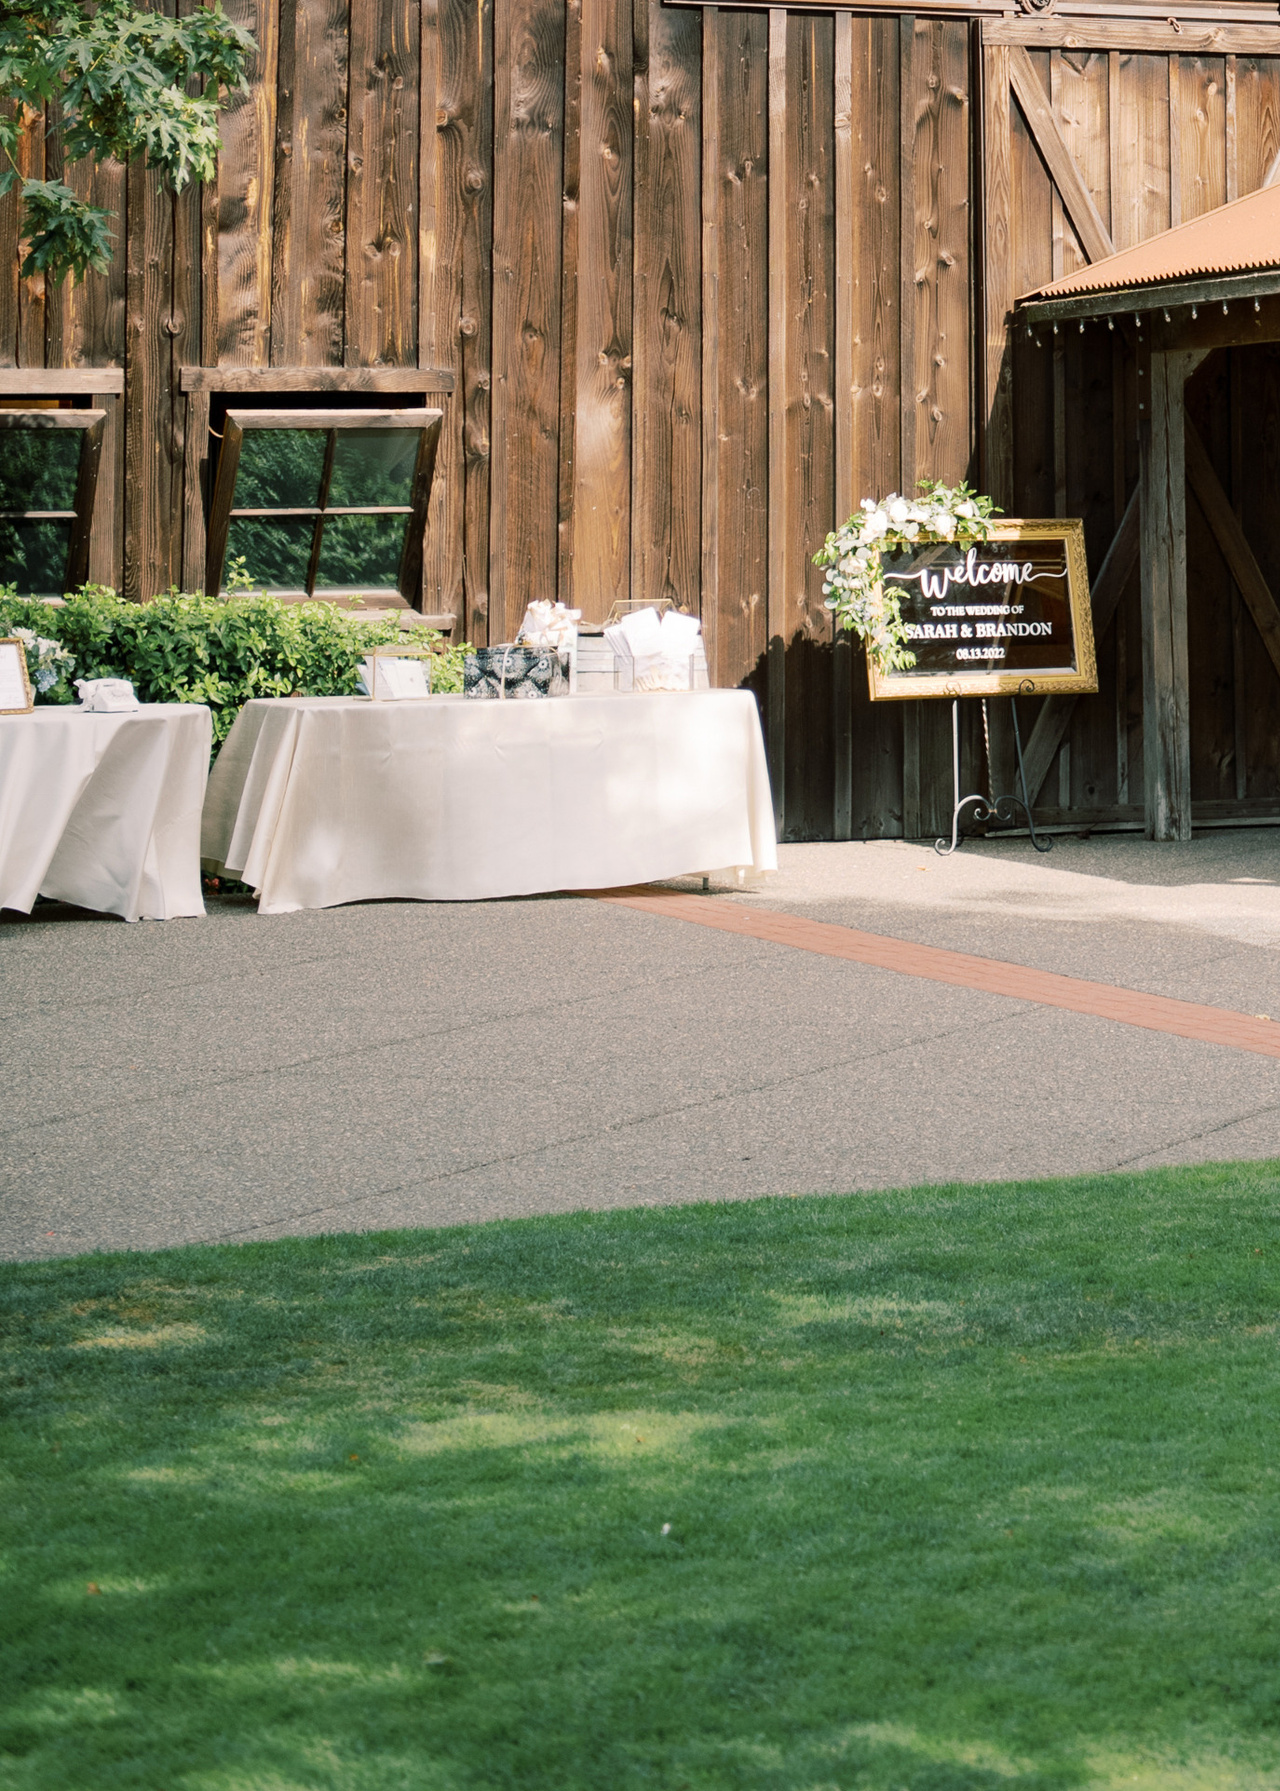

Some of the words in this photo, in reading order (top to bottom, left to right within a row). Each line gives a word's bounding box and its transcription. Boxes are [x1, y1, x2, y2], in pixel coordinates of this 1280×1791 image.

[930, 606, 945, 616] TO
[945, 606, 966, 616] THE
[965, 605, 1010, 616] WEDDING
[1011, 605, 1024, 614] OF
[905, 623, 958, 639] SARAH
[960, 624, 973, 638] &
[975, 622, 1052, 638] BRANDON
[956, 648, 1005, 660] 08.13.2022
